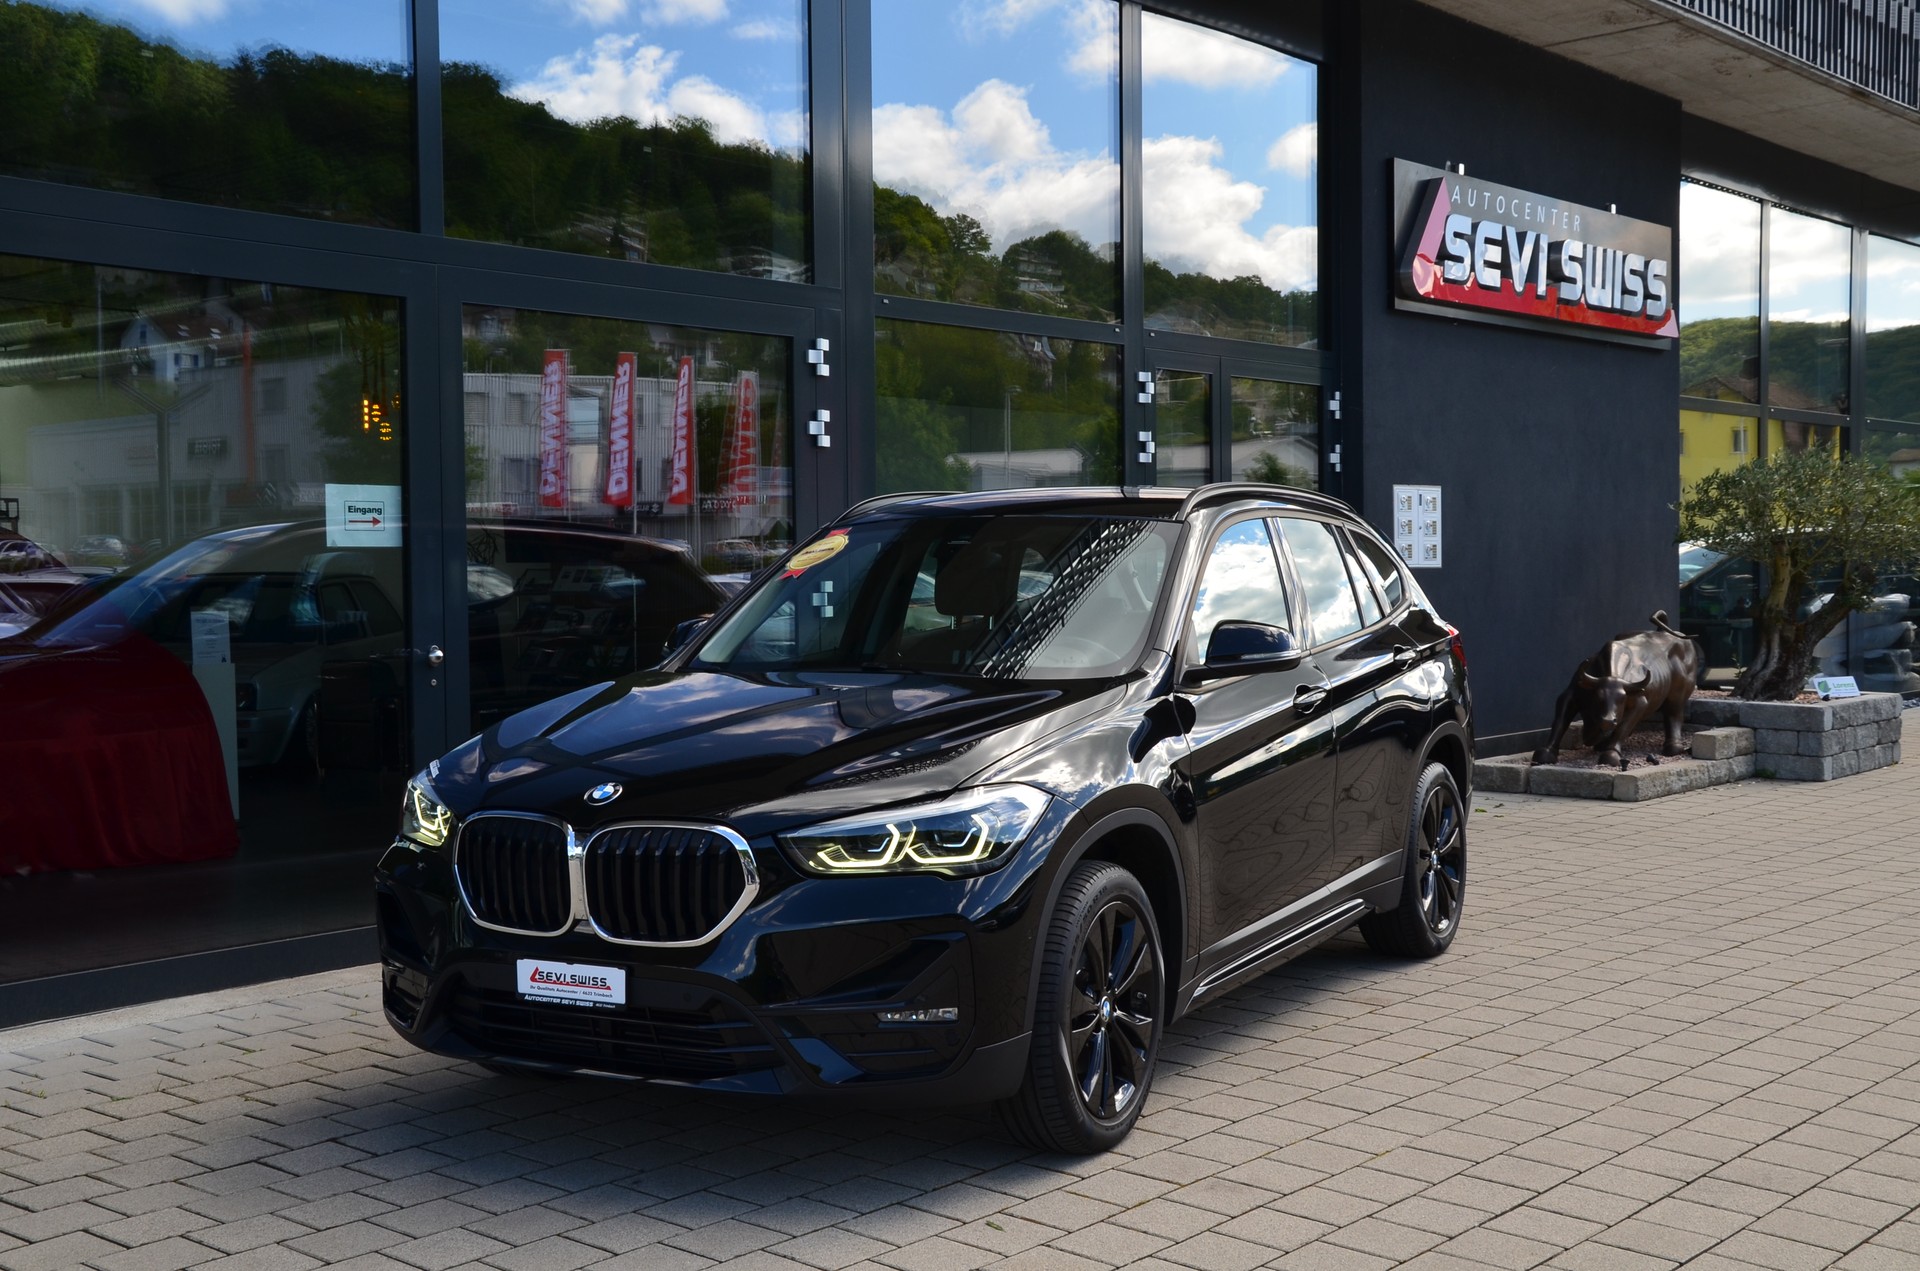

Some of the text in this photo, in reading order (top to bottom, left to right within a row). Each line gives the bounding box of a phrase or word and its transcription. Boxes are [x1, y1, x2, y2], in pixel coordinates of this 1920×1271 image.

[1451, 184, 1582, 232] AUTOCENTER
[1444, 213, 1668, 317] SEVI SWISS
[347, 505, 383, 515] Eingang
[537, 971, 607, 987] SEVI SWISS
